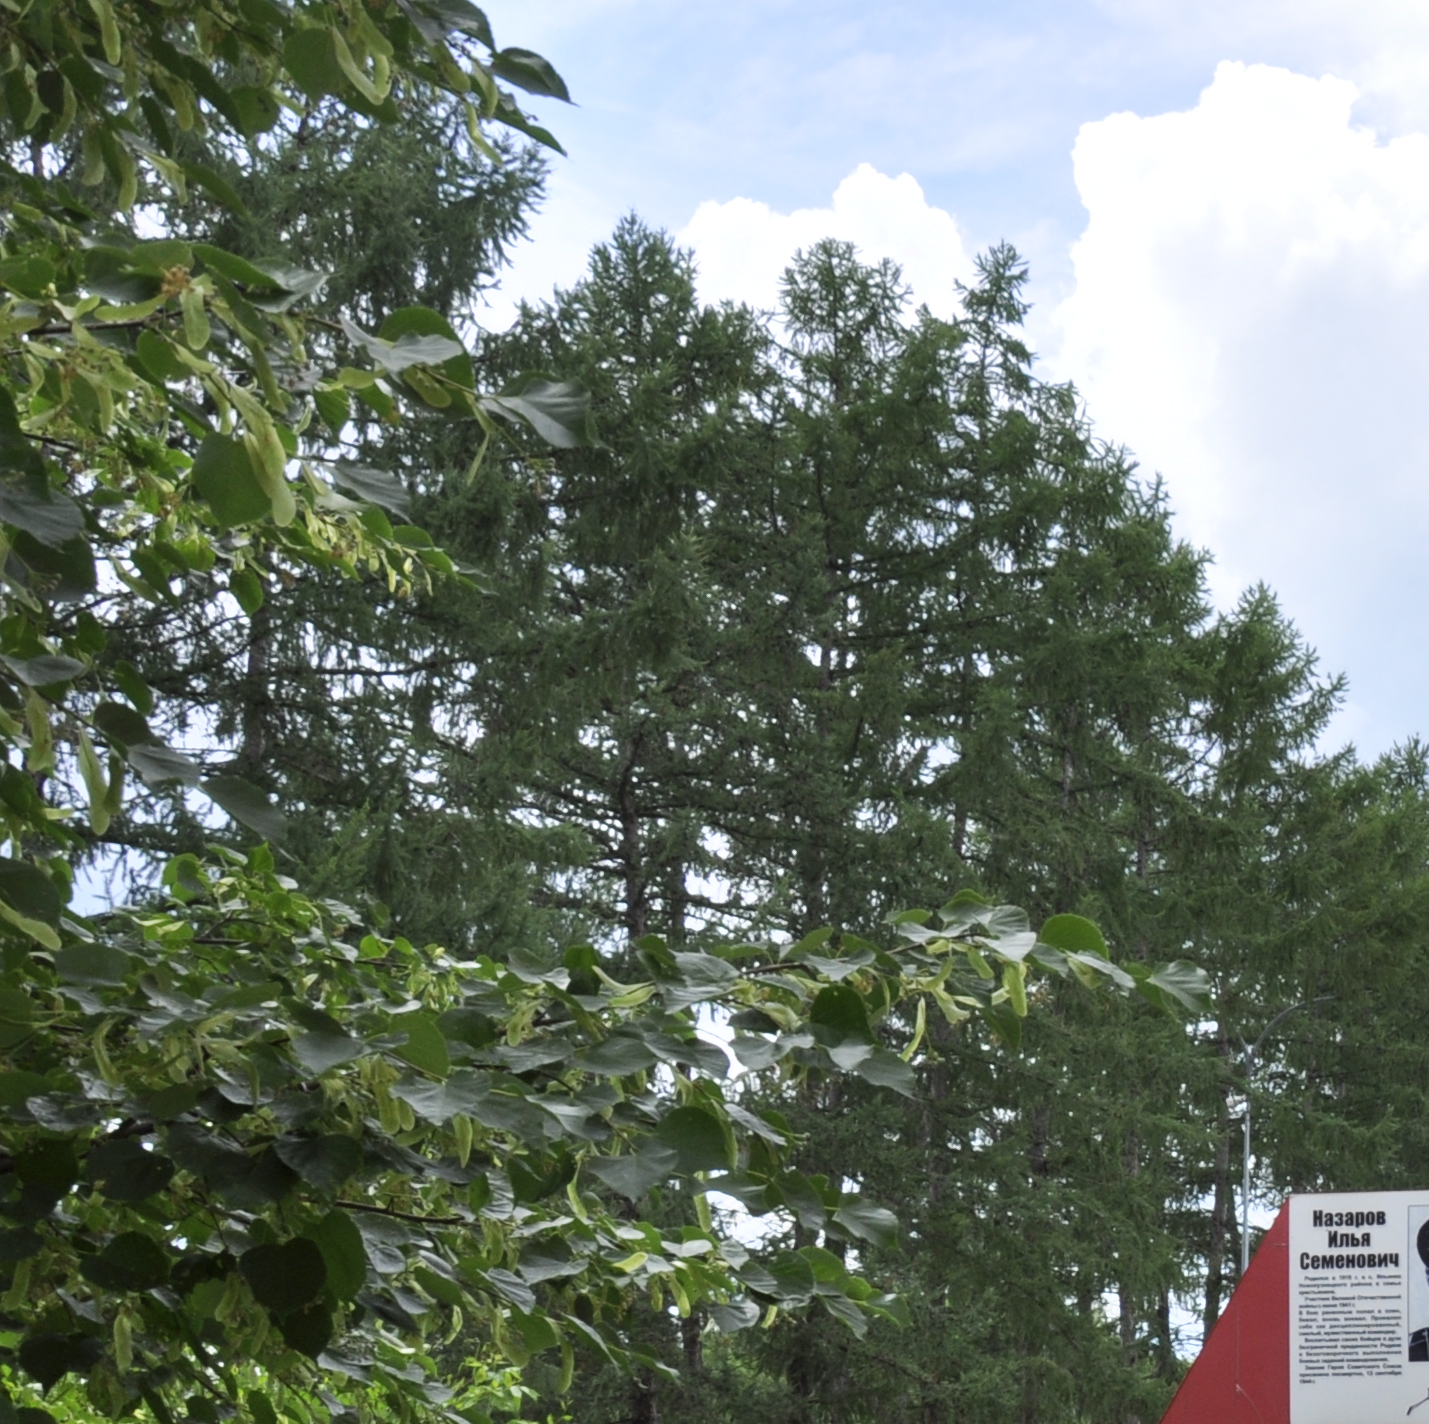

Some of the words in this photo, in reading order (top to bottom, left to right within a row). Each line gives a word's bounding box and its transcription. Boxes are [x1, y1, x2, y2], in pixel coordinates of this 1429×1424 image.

[1313, 1209, 1386, 1228] Назаров
[1328, 1230, 1371, 1248] Илья
[1300, 1252, 1399, 1270] Семенович
